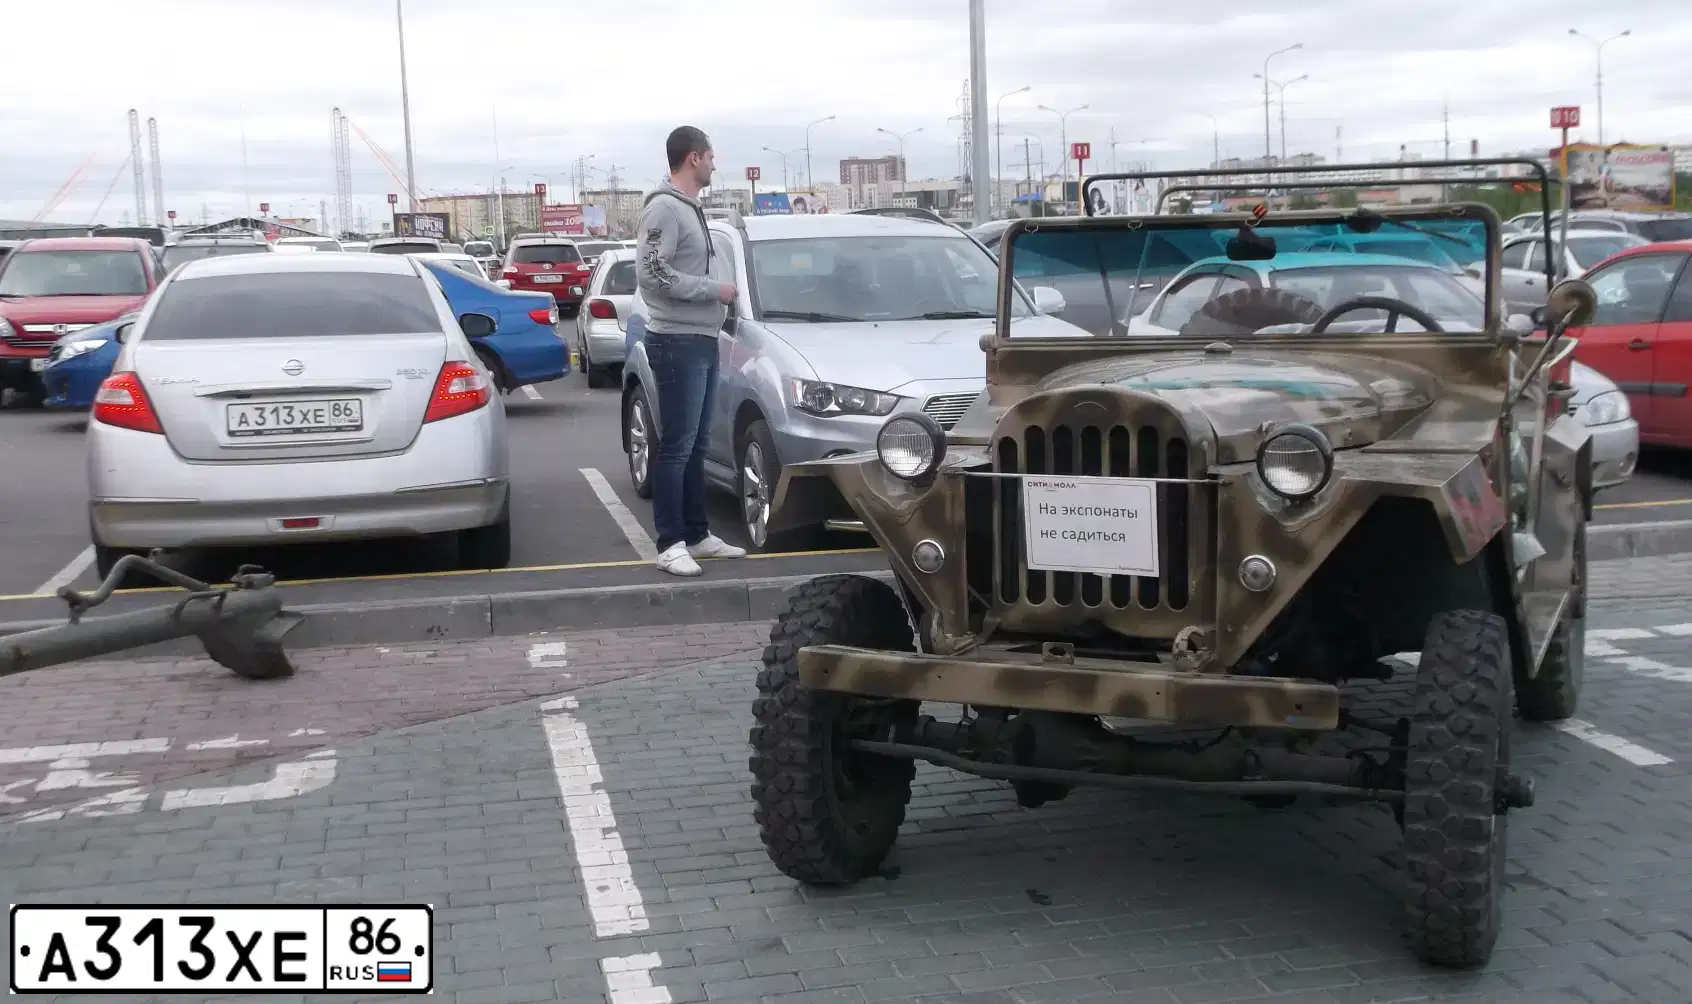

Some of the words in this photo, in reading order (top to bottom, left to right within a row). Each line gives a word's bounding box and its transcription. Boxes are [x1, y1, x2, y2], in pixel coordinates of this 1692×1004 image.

[1563, 110, 1578, 124] 10
[1076, 145, 1089, 156] 11
[749, 169, 759, 178] 12
[536, 185, 546, 193] 13
[238, 405, 325, 427] А313ХЕ
[332, 401, 353, 417] 86
[1027, 480, 1047, 488] СИТИ
[1039, 502, 1057, 515] На
[1061, 505, 1138, 519] экспонаты
[1040, 529, 1057, 539] не
[1061, 529, 1126, 543] садиться
